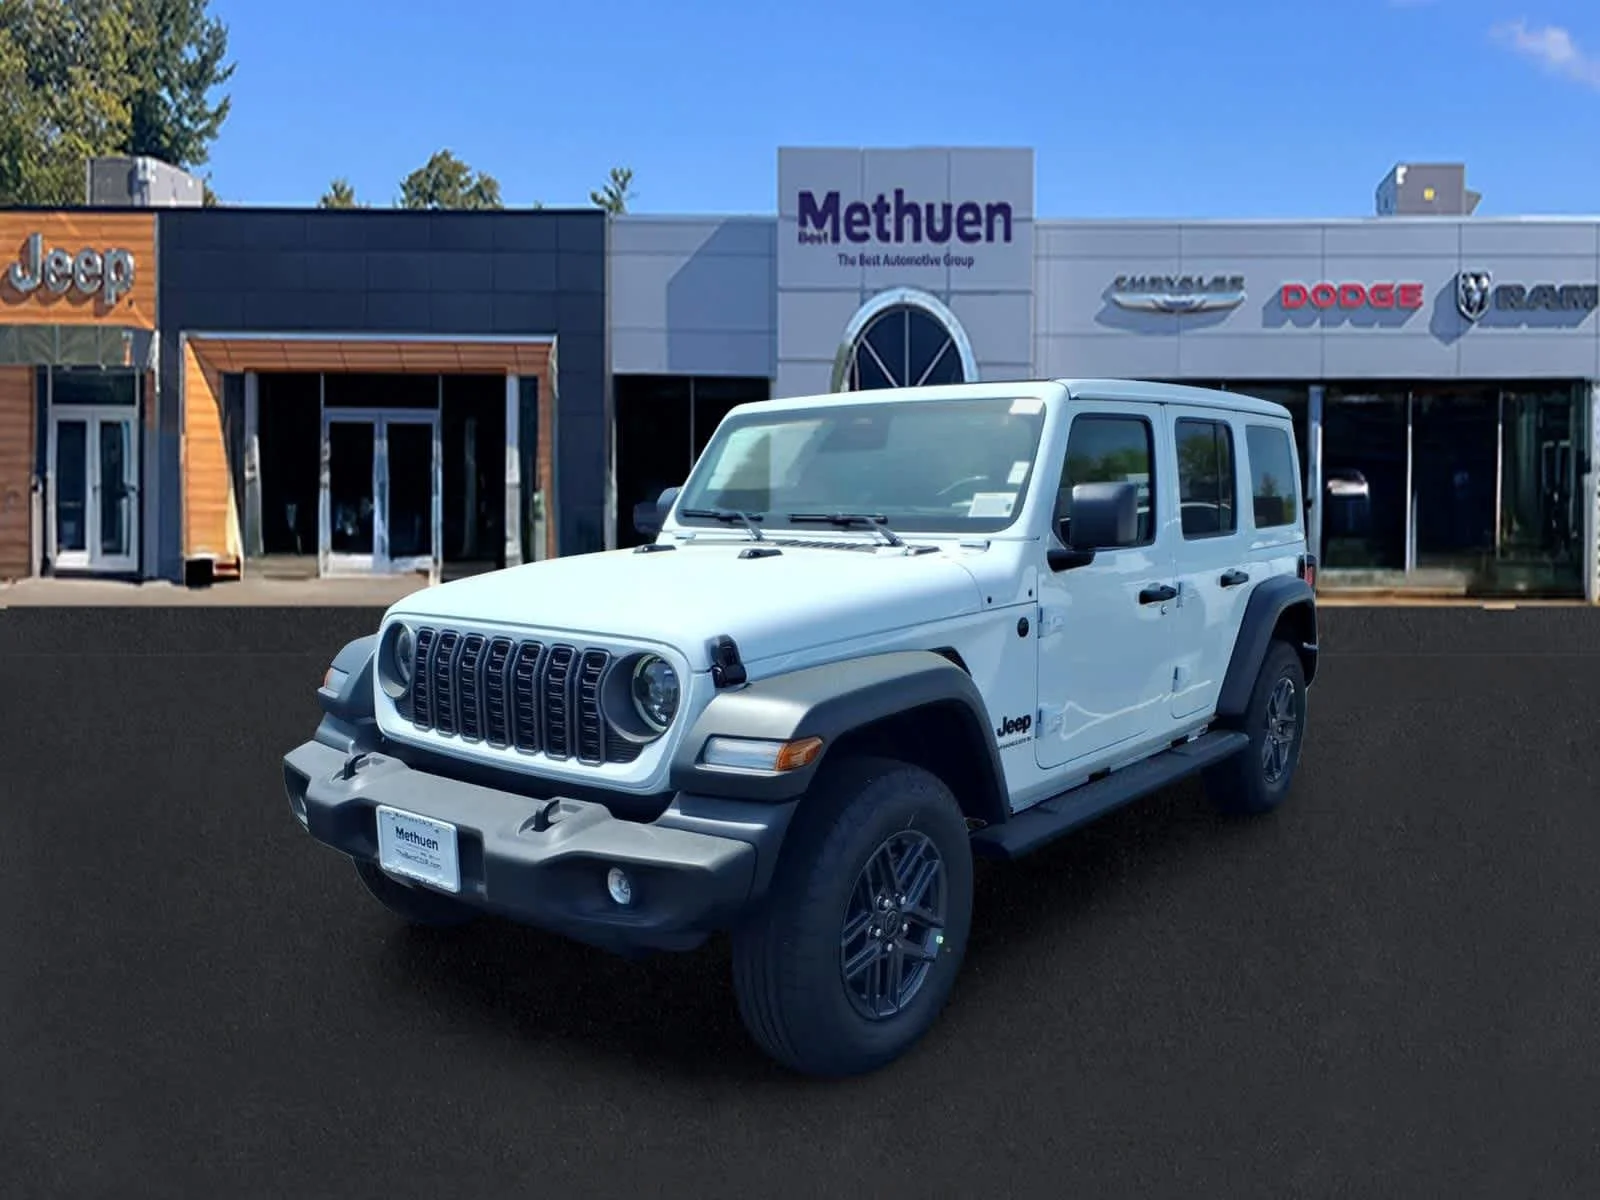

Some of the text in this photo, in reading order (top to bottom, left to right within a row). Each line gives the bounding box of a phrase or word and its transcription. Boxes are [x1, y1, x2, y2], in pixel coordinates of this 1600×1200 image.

[798, 188, 1012, 244] Methuen
[8, 232, 135, 305] Jeep
[838, 253, 975, 270] The Best Automotive Group
[1114, 275, 1245, 291] CHRYSLER
[1281, 283, 1424, 309] DODGE
[1495, 284, 1598, 311] RAM
[996, 714, 1032, 737] Jeep
[395, 825, 439, 850] Methuen
